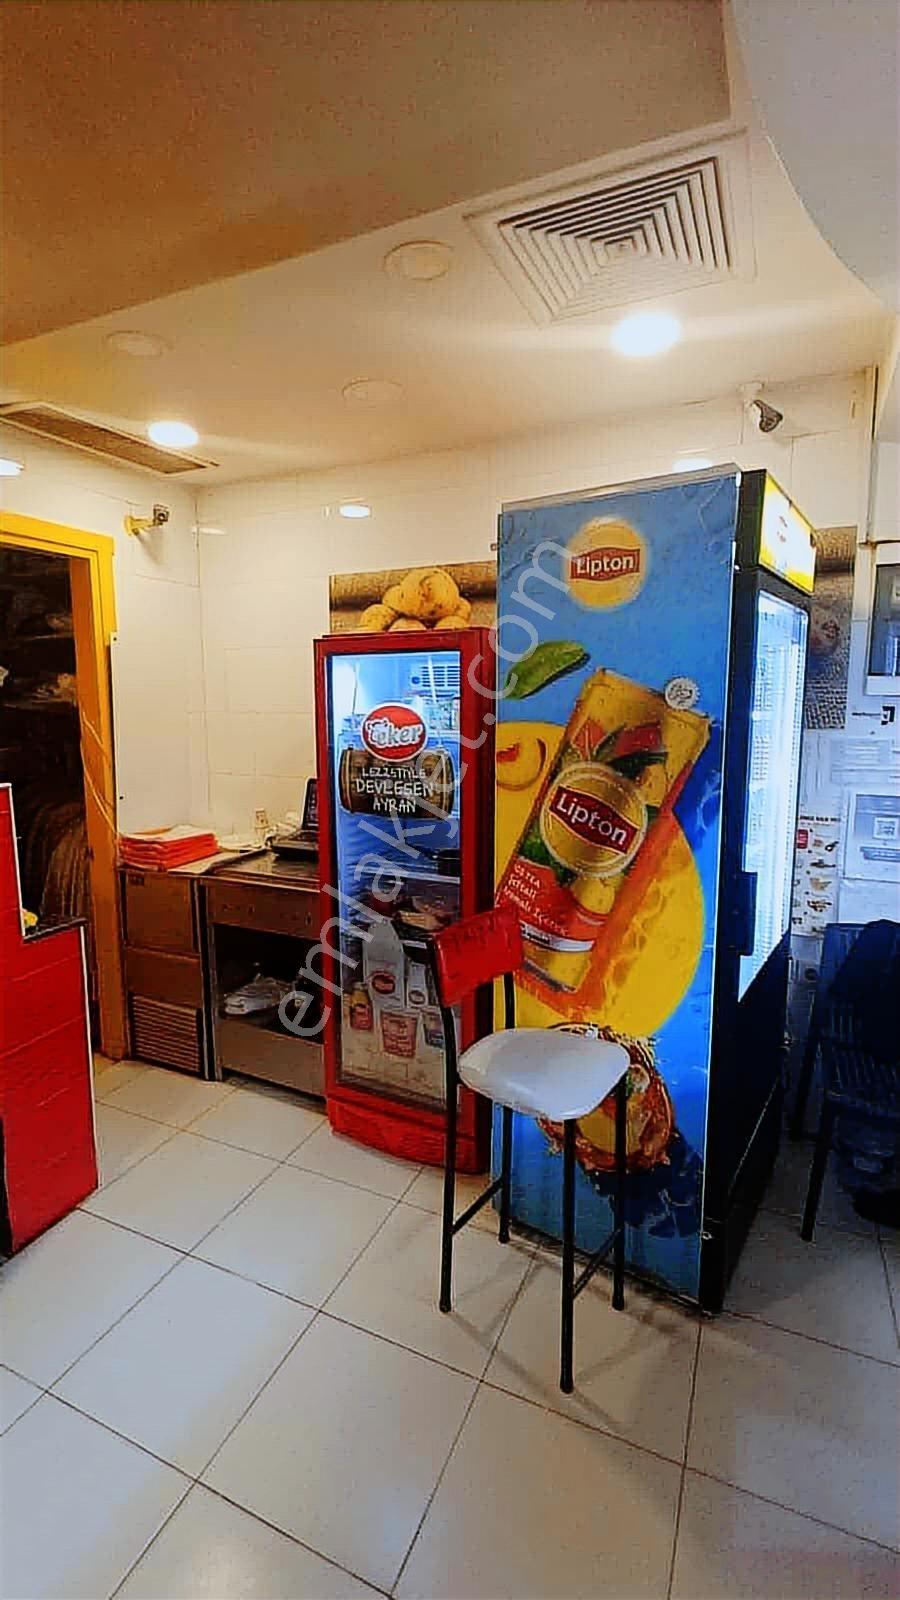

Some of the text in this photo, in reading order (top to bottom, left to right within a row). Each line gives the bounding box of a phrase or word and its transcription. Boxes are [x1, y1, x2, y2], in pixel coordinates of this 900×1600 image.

[576, 555, 634, 577] Lipton
[372, 797, 416, 814] AYRAN
[556, 793, 628, 846] Lipton
